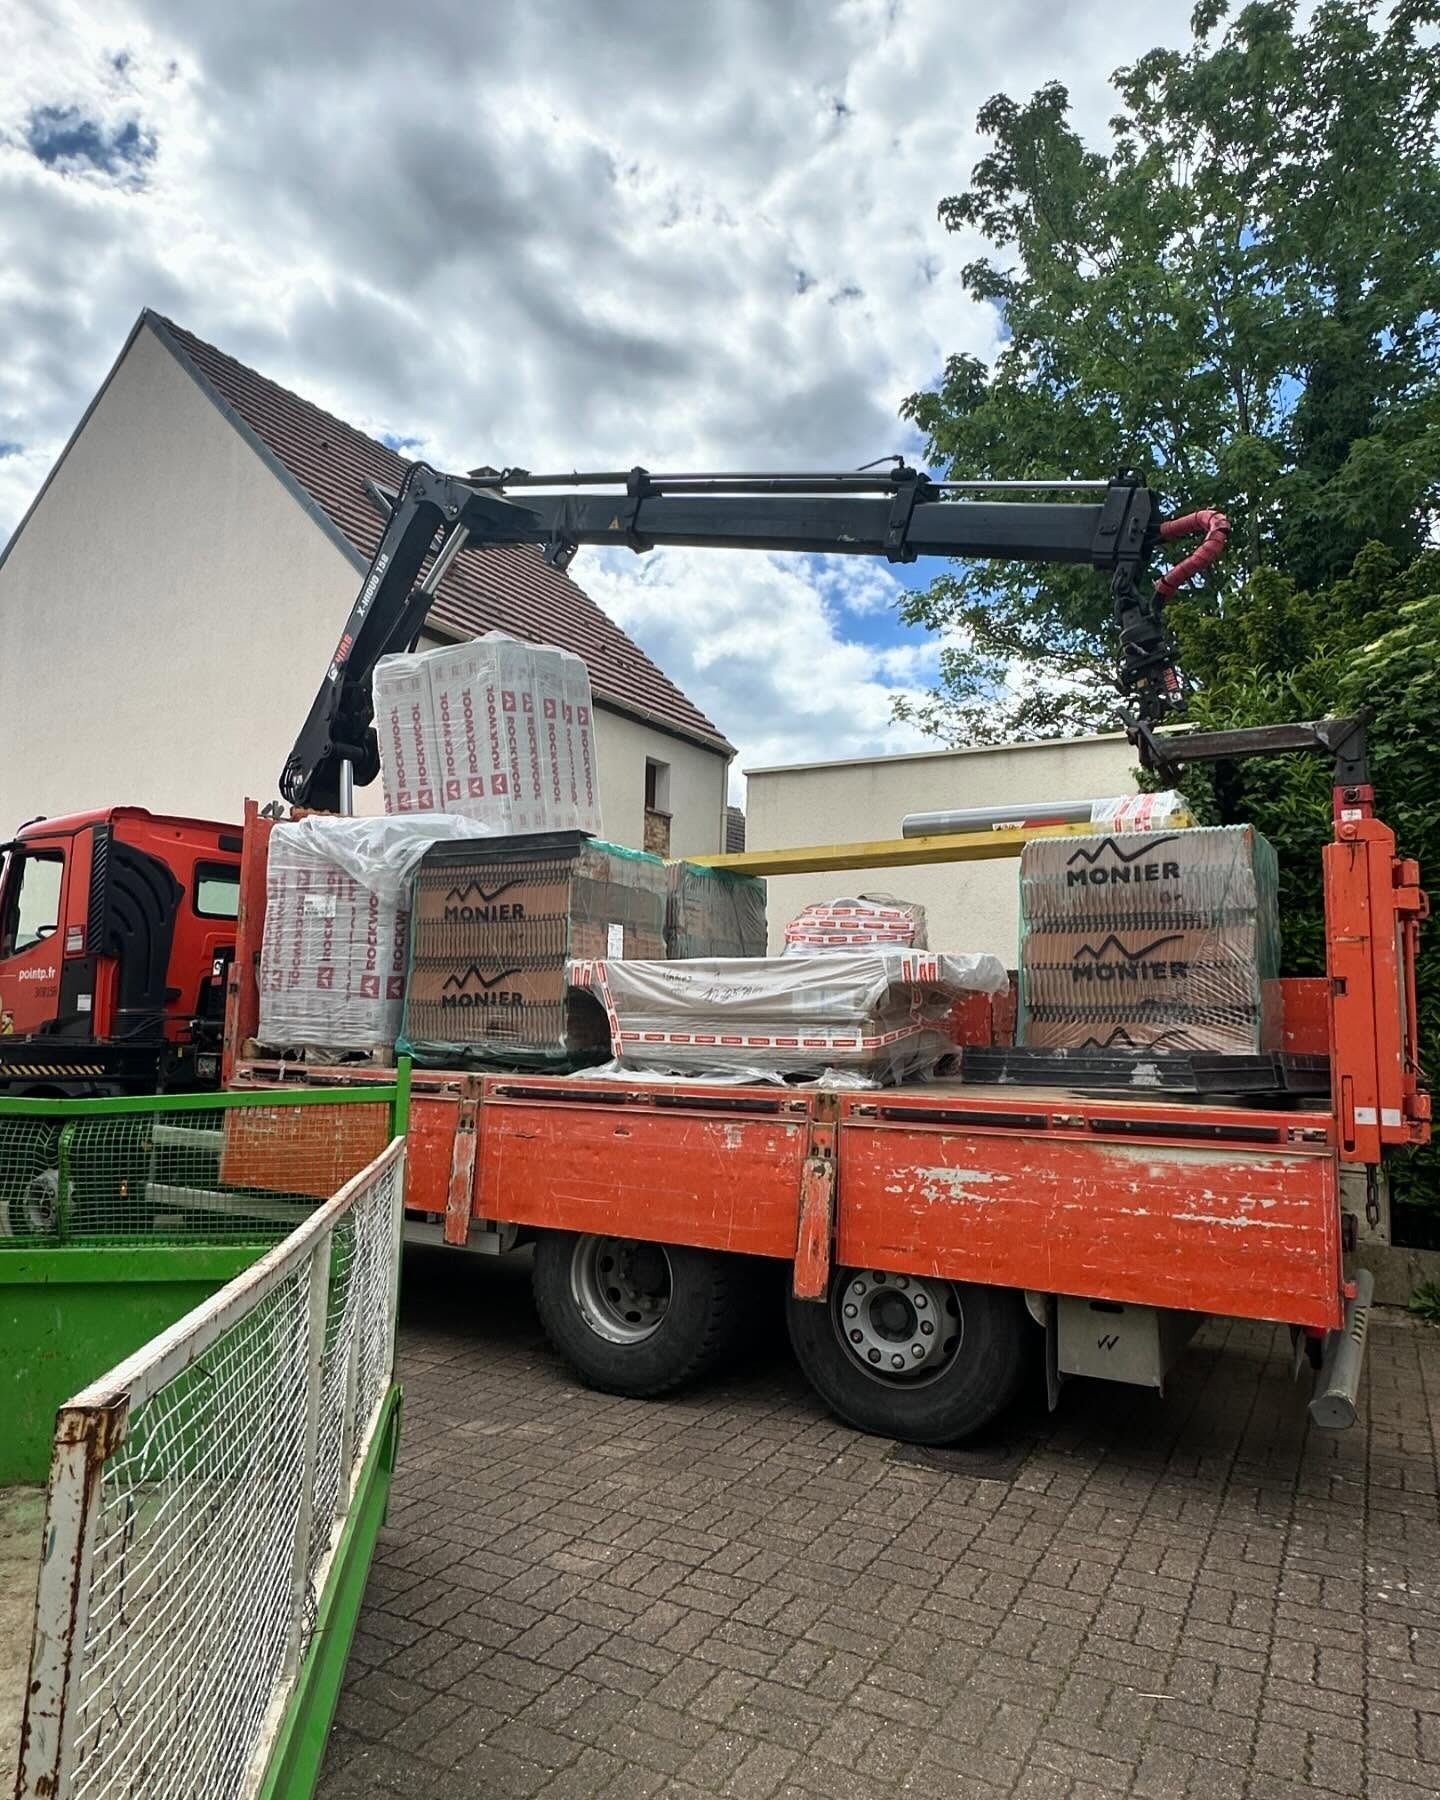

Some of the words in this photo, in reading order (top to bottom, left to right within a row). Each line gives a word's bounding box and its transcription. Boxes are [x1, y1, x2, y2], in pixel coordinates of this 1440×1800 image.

[390, 706, 406, 788] ROCKWOOL
[411, 703, 428, 786] ROCKWOOL
[440, 692, 456, 776] ROCKWOOL
[462, 688, 478, 774] ROCKWOOL
[486, 685, 501, 770] ROCKWOOL
[506, 716, 522, 801] ROCKWOOL
[548, 723, 561, 804] ROCKWOOL
[581, 729, 593, 807] ROCKWOOL
[444, 903, 524, 921] MONIER
[1067, 862, 1180, 887] MONIER
[366, 892, 379, 970] ROCKWO
[392, 910, 408, 971] ROCKW
[19, 966, 56, 982] pointp.fr
[442, 992, 523, 1008] MONIER
[1072, 961, 1188, 982] MONIER
